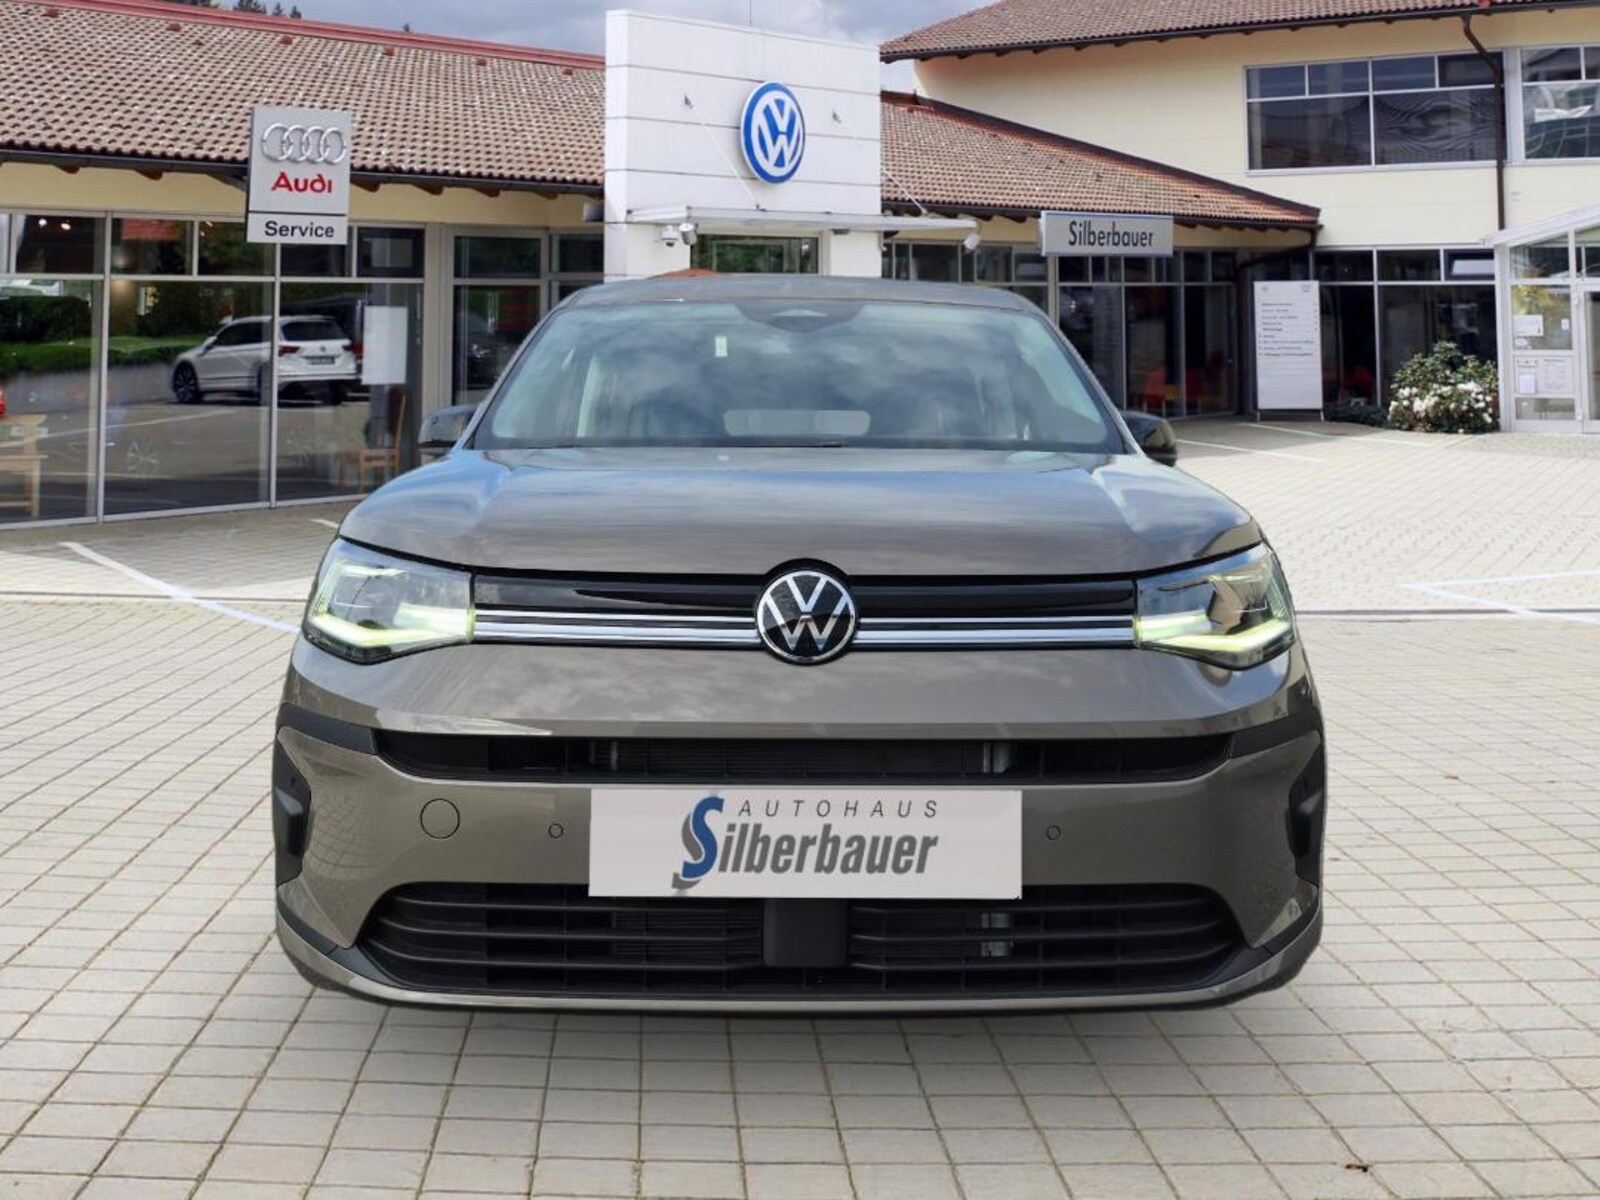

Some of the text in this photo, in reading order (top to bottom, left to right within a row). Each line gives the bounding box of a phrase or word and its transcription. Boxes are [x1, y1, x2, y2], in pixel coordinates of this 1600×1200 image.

[271, 171, 333, 193] Audi
[264, 220, 334, 238] Service
[1068, 220, 1154, 247] Silberbauer
[738, 799, 939, 818] AUTOHAUS
[672, 794, 939, 890] Silberbauer
